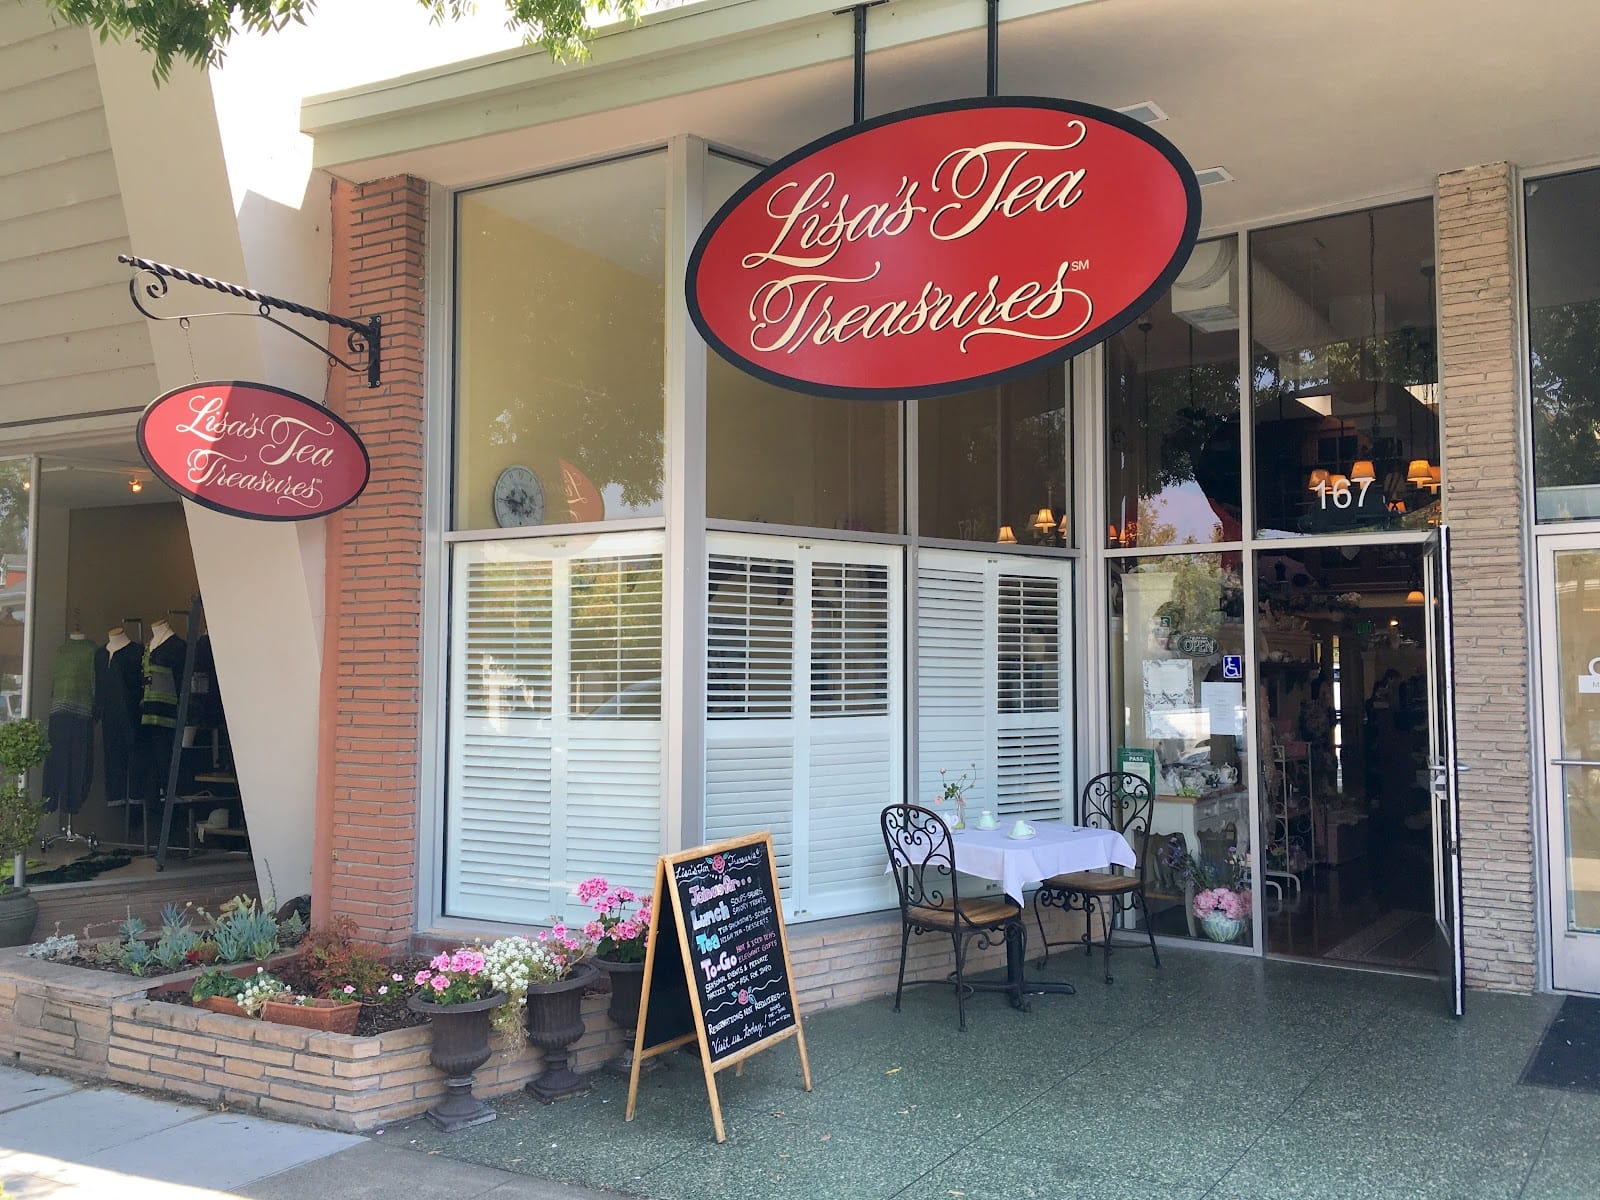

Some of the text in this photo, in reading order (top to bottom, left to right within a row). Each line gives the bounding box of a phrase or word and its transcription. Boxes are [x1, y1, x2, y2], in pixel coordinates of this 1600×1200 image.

[741, 119, 1088, 269] Lisa's Tea
[749, 261, 1094, 355] Treasures
[175, 395, 335, 468] Lisa's Tea
[186, 448, 324, 509] Treasures
[1314, 476, 1373, 509] 167
[1184, 639, 1214, 653] OPEN
[690, 900, 731, 931] Lunch
[745, 916, 769, 932] DESSERTS
[696, 931, 721, 955] Tea
[738, 939, 777, 963] ELEGANT GIFTS
[700, 951, 738, 981] To-Go
[727, 966, 744, 980] EVENTS
[748, 953, 769, 969] PRIVATE
[706, 986, 727, 1001] PARTIES
[707, 1010, 744, 1036] RESERVATIONS
[743, 1004, 754, 1017] NOT
[712, 1036, 731, 1054] Visit
[731, 1034, 743, 1045] us
